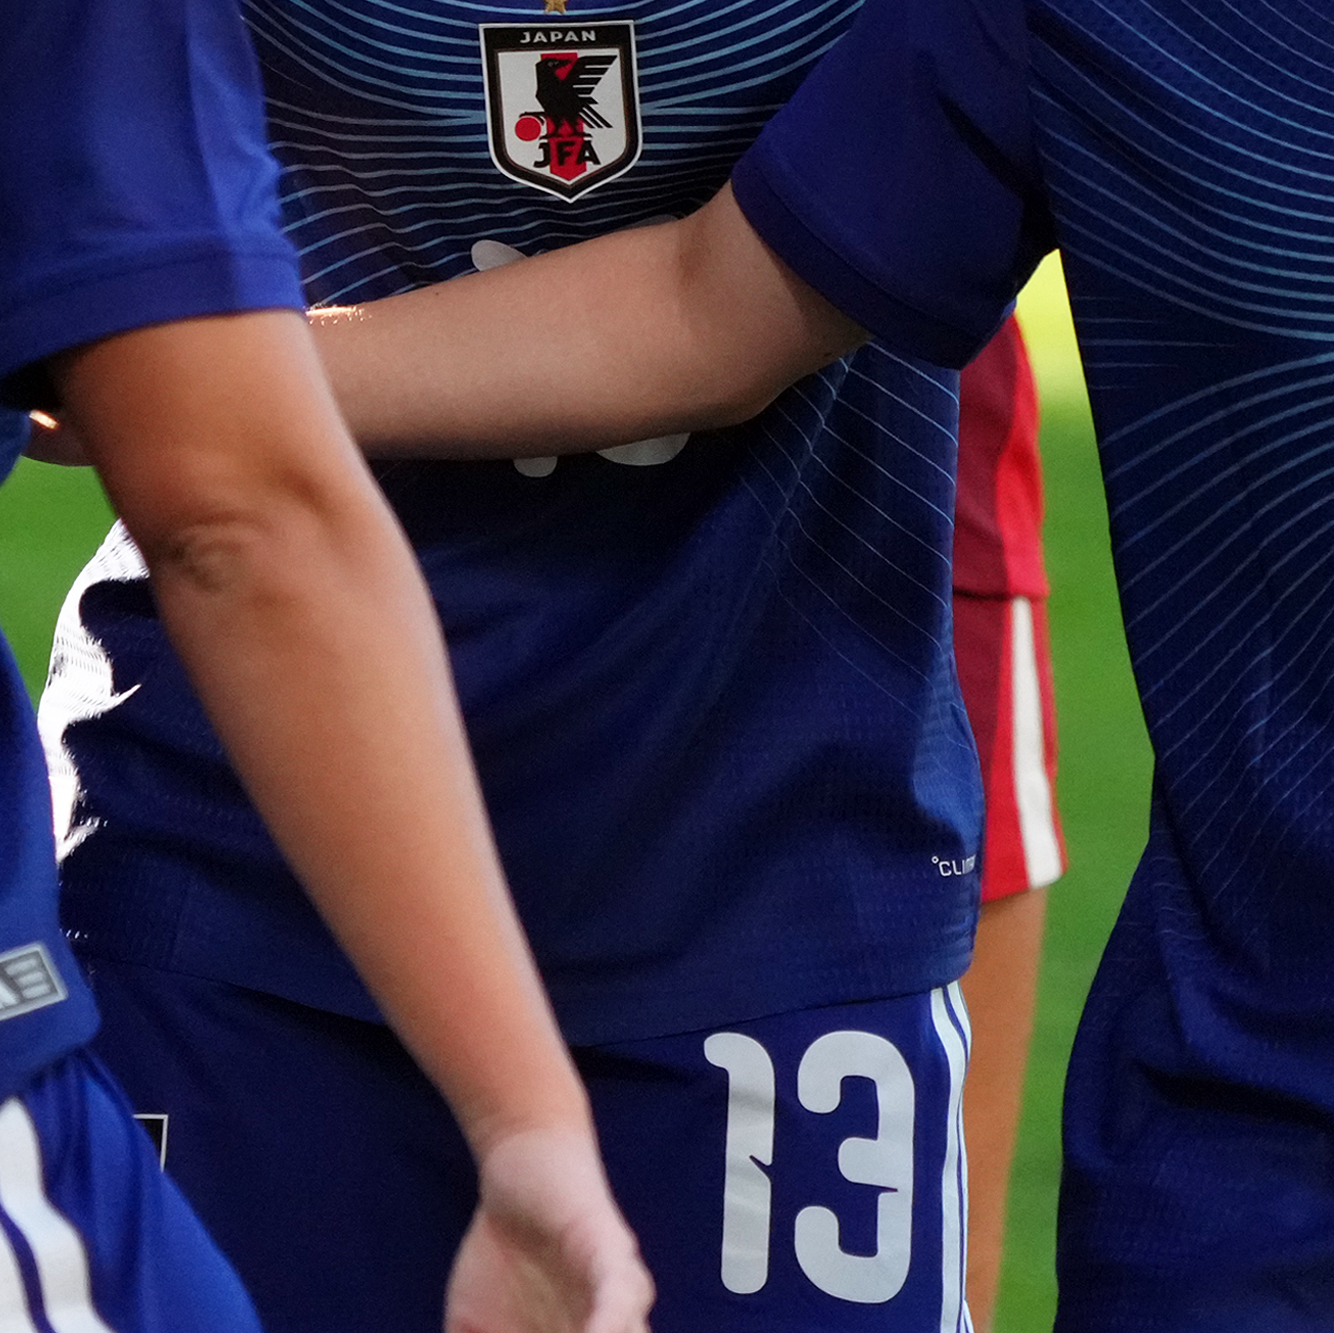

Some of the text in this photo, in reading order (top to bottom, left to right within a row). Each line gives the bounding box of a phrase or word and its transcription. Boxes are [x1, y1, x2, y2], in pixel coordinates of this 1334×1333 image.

[519, 30, 597, 44] JAPAN
[533, 140, 602, 168] JFA
[703, 1030, 916, 1304] 13
